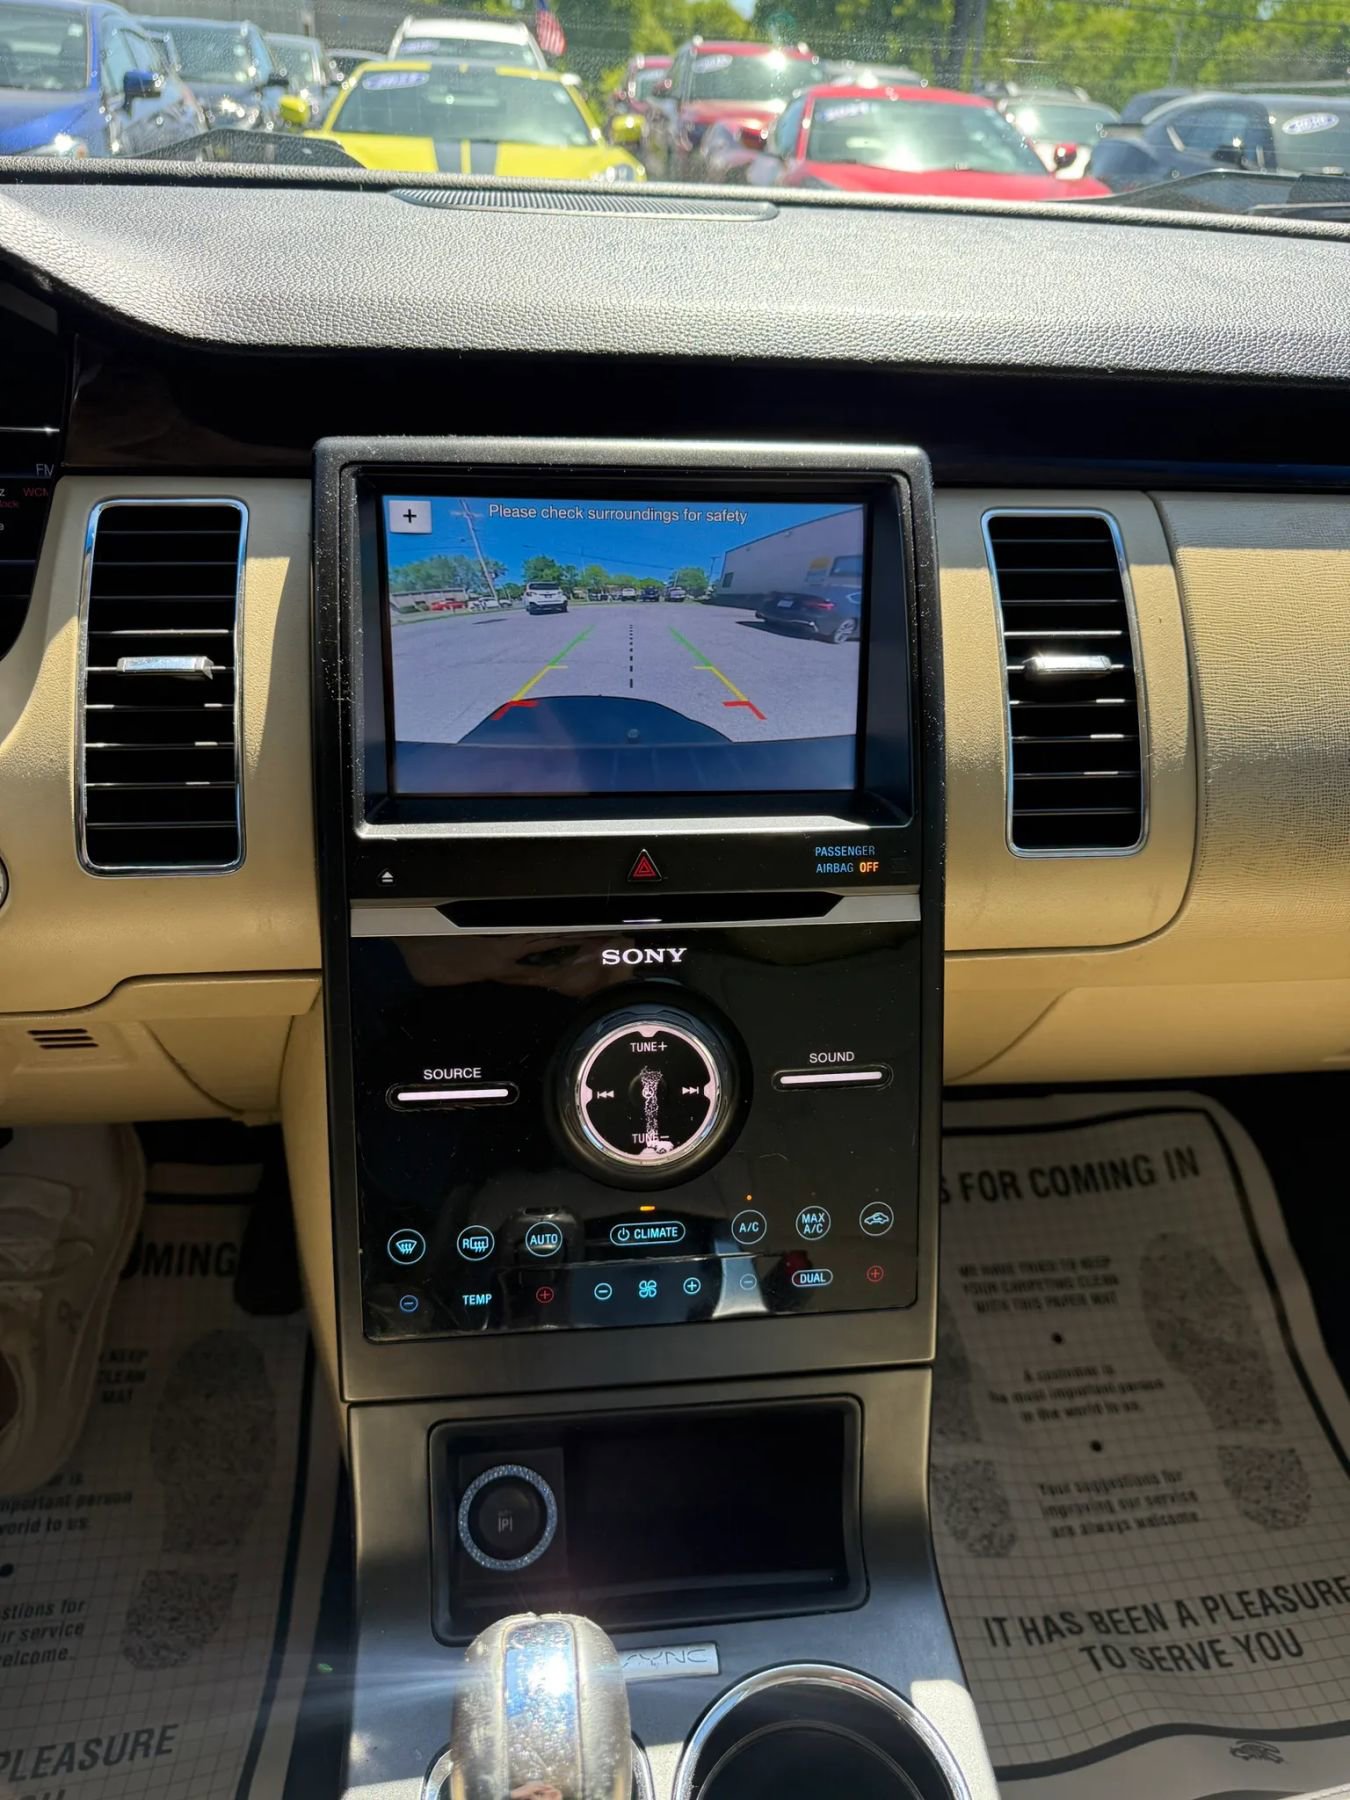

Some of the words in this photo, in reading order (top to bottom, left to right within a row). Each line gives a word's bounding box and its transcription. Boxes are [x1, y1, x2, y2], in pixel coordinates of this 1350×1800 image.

[489, 504, 537, 518] Please
[541, 506, 583, 520] check
[588, 508, 679, 524] surroundings
[683, 509, 701, 521] for
[706, 509, 748, 525] safety
[815, 846, 876, 857] PASSENGER
[816, 863, 854, 873] AIRBAG
[859, 862, 879, 873] OFF
[602, 948, 687, 965] SONY
[809, 1051, 855, 1063] SOUND
[423, 1067, 482, 1080] SOURCE
[959, 1170, 1021, 1203] FOR
[1030, 1154, 1156, 1199] COMING
[1162, 1145, 1200, 1181] IN
[802, 1213, 825, 1224] MAX
[634, 1226, 678, 1239] CLIMATE
[739, 1222, 759, 1233] A/C
[803, 1223, 824, 1235] A/C
[530, 1233, 558, 1245] AUTO
[120, 1242, 236, 1278] MING
[800, 1273, 826, 1284] DUAL
[462, 1293, 492, 1306] TEMP
[60, 1600, 85, 1616] for
[984, 1617, 1011, 1647] IT
[1020, 1611, 1083, 1647] HAS
[1088, 1603, 1169, 1635] BEEN
[1176, 1600, 1198, 1628] A
[1200, 1576, 1350, 1624] PLEASURE
[19, 1623, 85, 1642] service
[1080, 1645, 1126, 1672] TO
[1130, 1639, 1233, 1673] SERVE
[1232, 1628, 1305, 1663] YOU
[0, 1724, 178, 1782] PLEASURE
